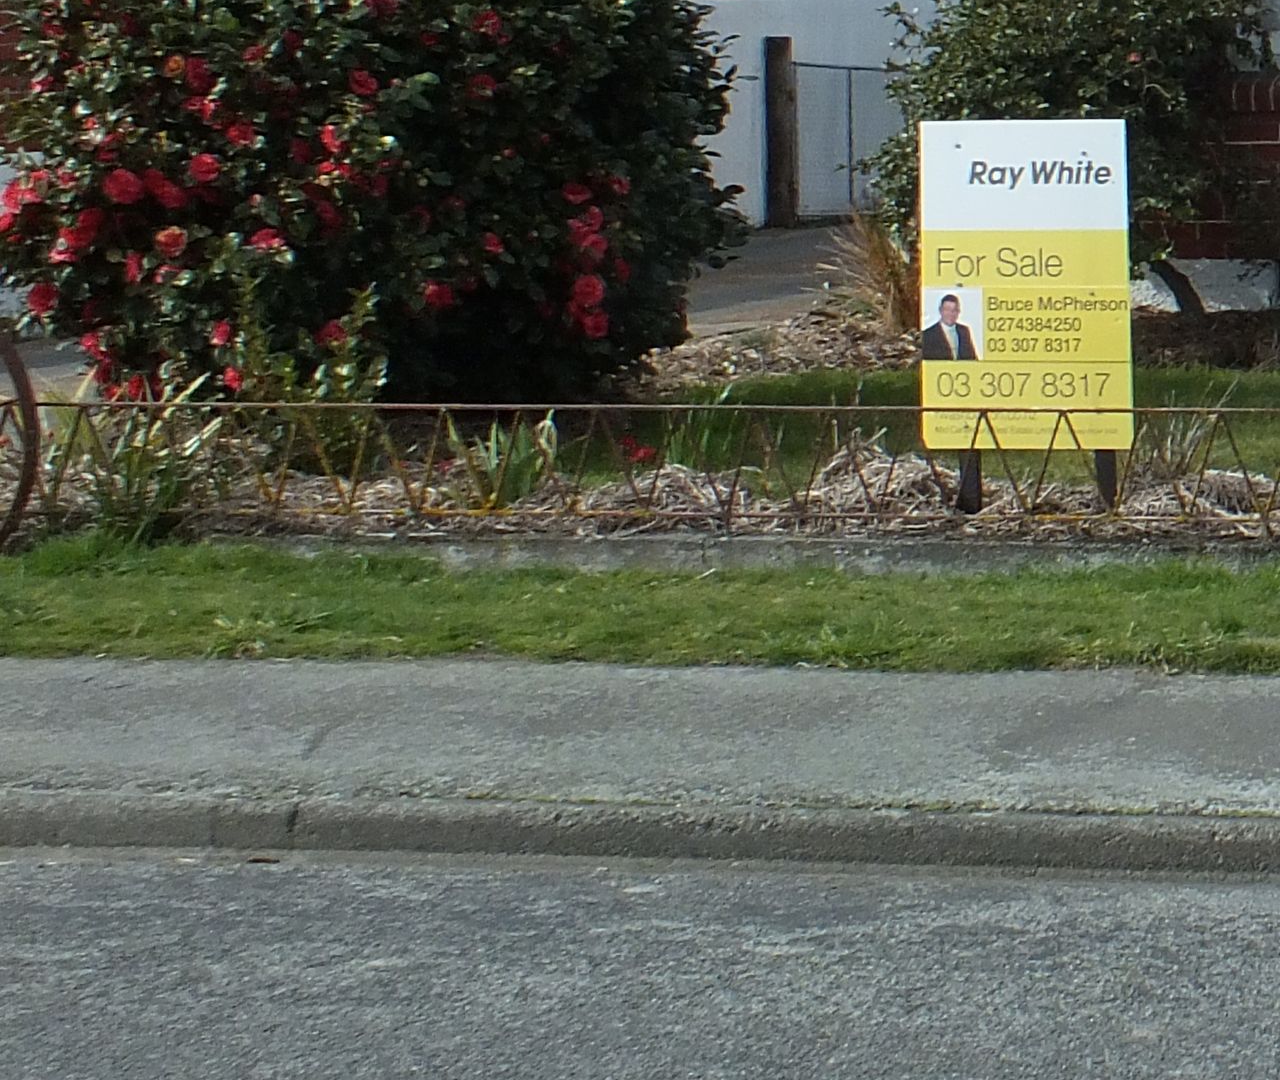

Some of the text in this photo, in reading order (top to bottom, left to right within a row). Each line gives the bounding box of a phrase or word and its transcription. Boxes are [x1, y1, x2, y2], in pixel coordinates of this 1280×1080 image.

[969, 160, 1112, 190] Ray White
[936, 247, 1064, 277] For Sale
[987, 296, 1128, 311] Bruce McPherson
[987, 317, 1082, 332] 0274384250
[987, 337, 1082, 352] 03 307 8317
[936, 372, 1112, 398] 03 307 8317
